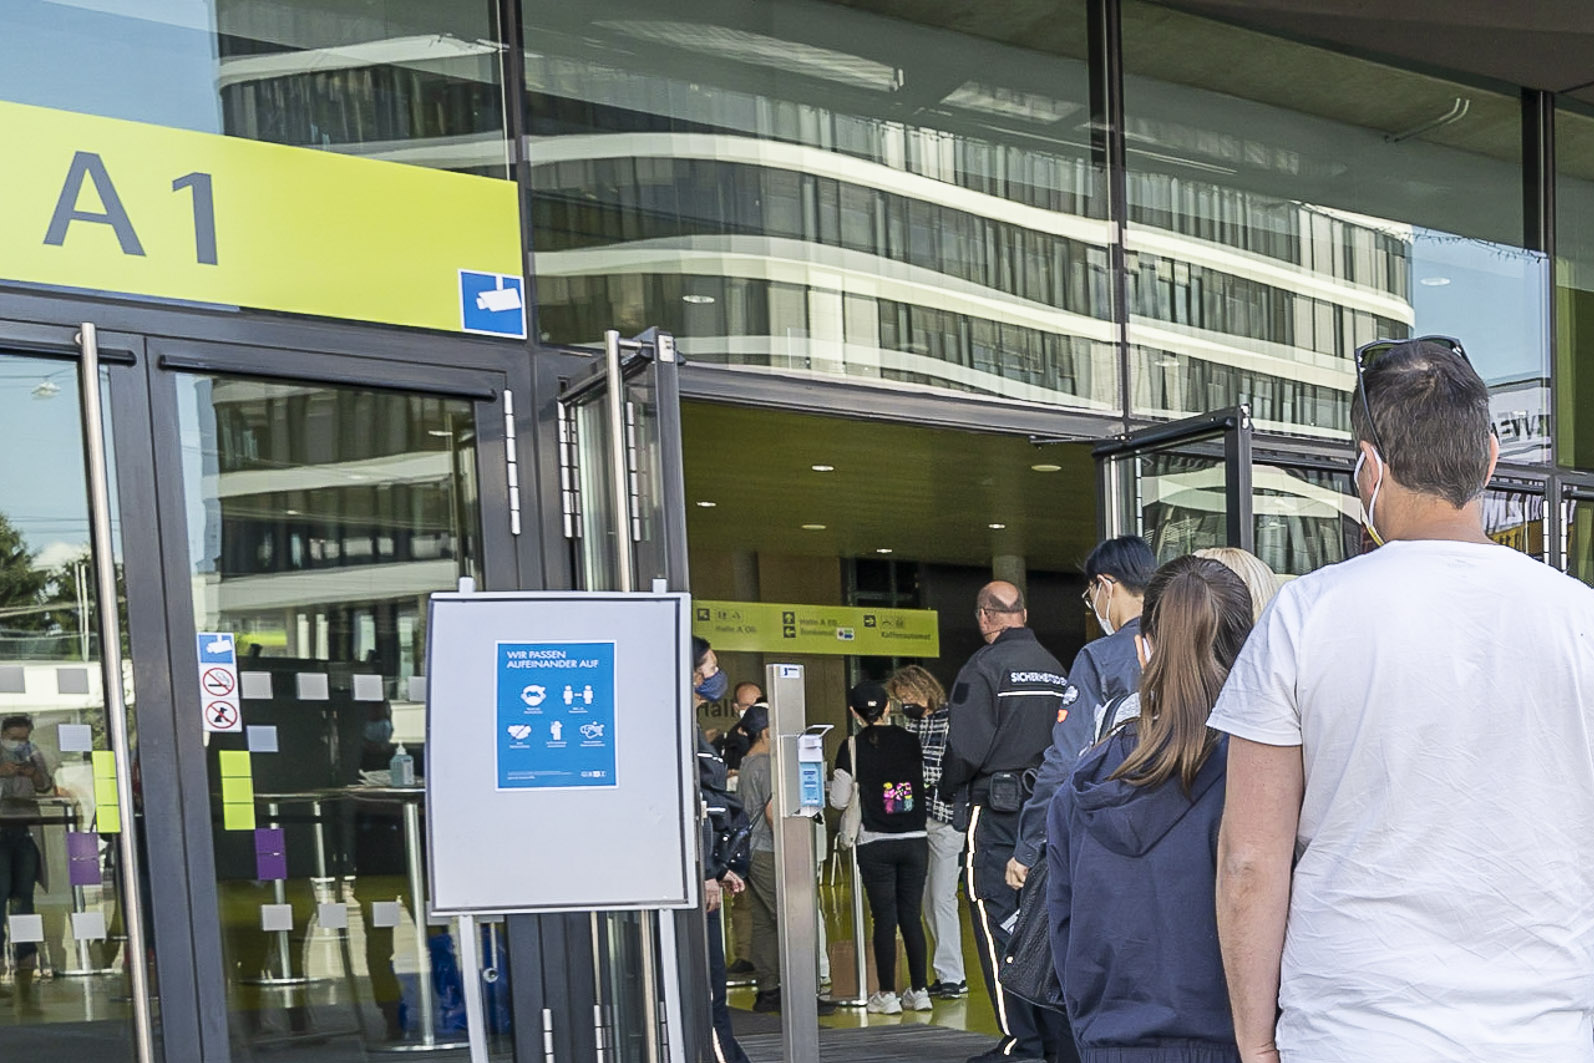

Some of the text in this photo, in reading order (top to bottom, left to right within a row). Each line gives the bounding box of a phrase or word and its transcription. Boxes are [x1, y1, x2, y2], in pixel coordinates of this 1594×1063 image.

[43, 151, 218, 266] A1
[506, 649, 567, 659] WIR PASSEN
[506, 659, 599, 669] AUFEINANDER AUF
